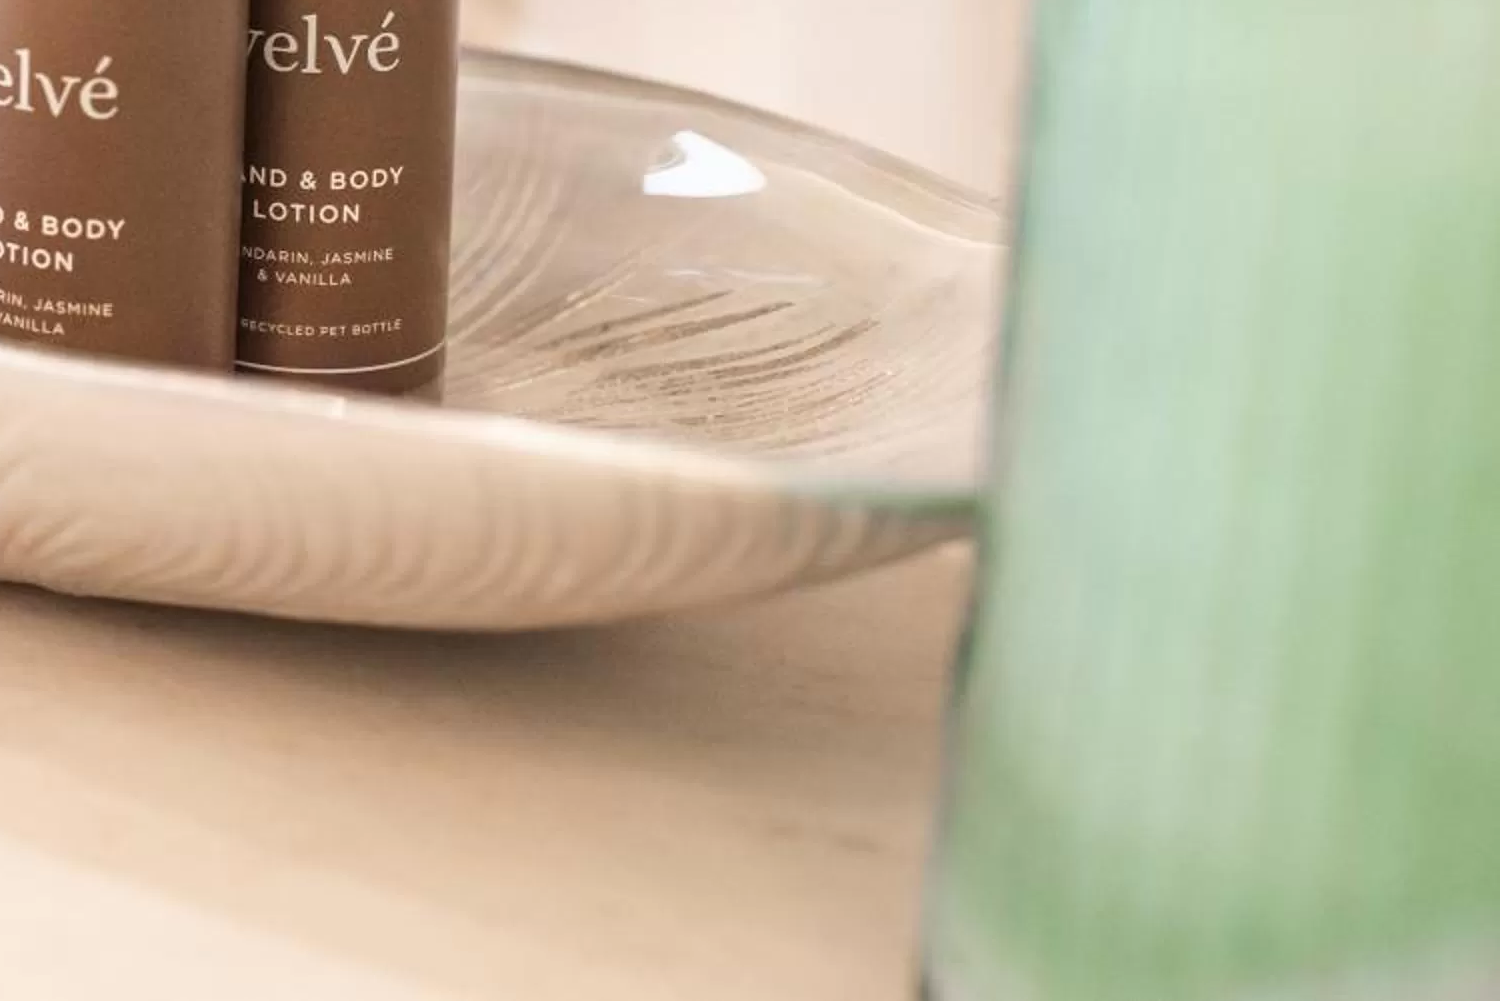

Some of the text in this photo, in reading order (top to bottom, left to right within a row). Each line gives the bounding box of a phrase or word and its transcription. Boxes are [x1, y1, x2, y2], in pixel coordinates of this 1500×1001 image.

[240, 166, 404, 191] ND & BODY
[252, 199, 361, 225] LOTION
[14, 210, 30, 232] &
[41, 215, 126, 240] BODY
[242, 246, 395, 267] NDARIN, JASMINE
[257, 269, 353, 287] & VANILLA
[33, 298, 115, 318] JASMINE
[318, 325, 348, 337] PET
[350, 318, 404, 336] BOTTLE
